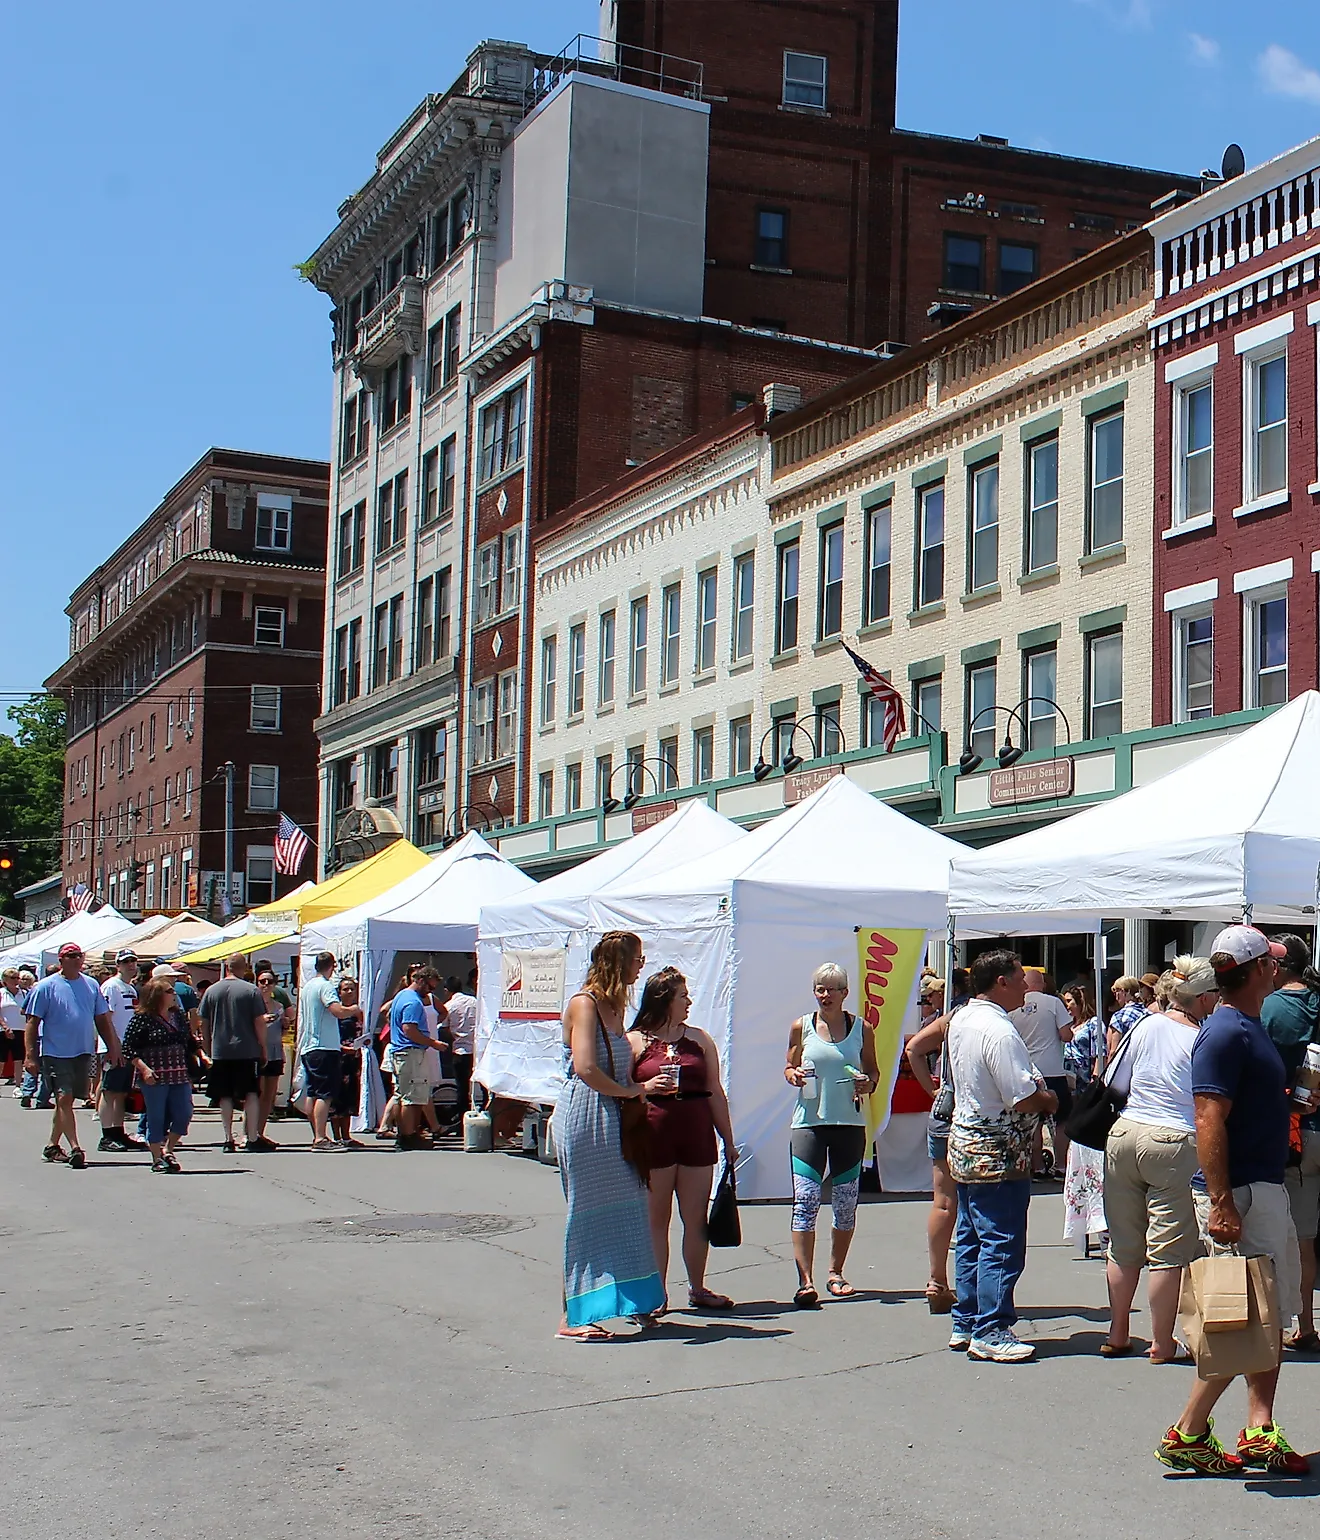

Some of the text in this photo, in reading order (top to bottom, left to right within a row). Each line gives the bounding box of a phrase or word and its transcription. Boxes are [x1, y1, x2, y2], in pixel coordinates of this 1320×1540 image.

[995, 766, 1065, 785] Little Falls Senior
[993, 779, 1065, 798] Community Center
